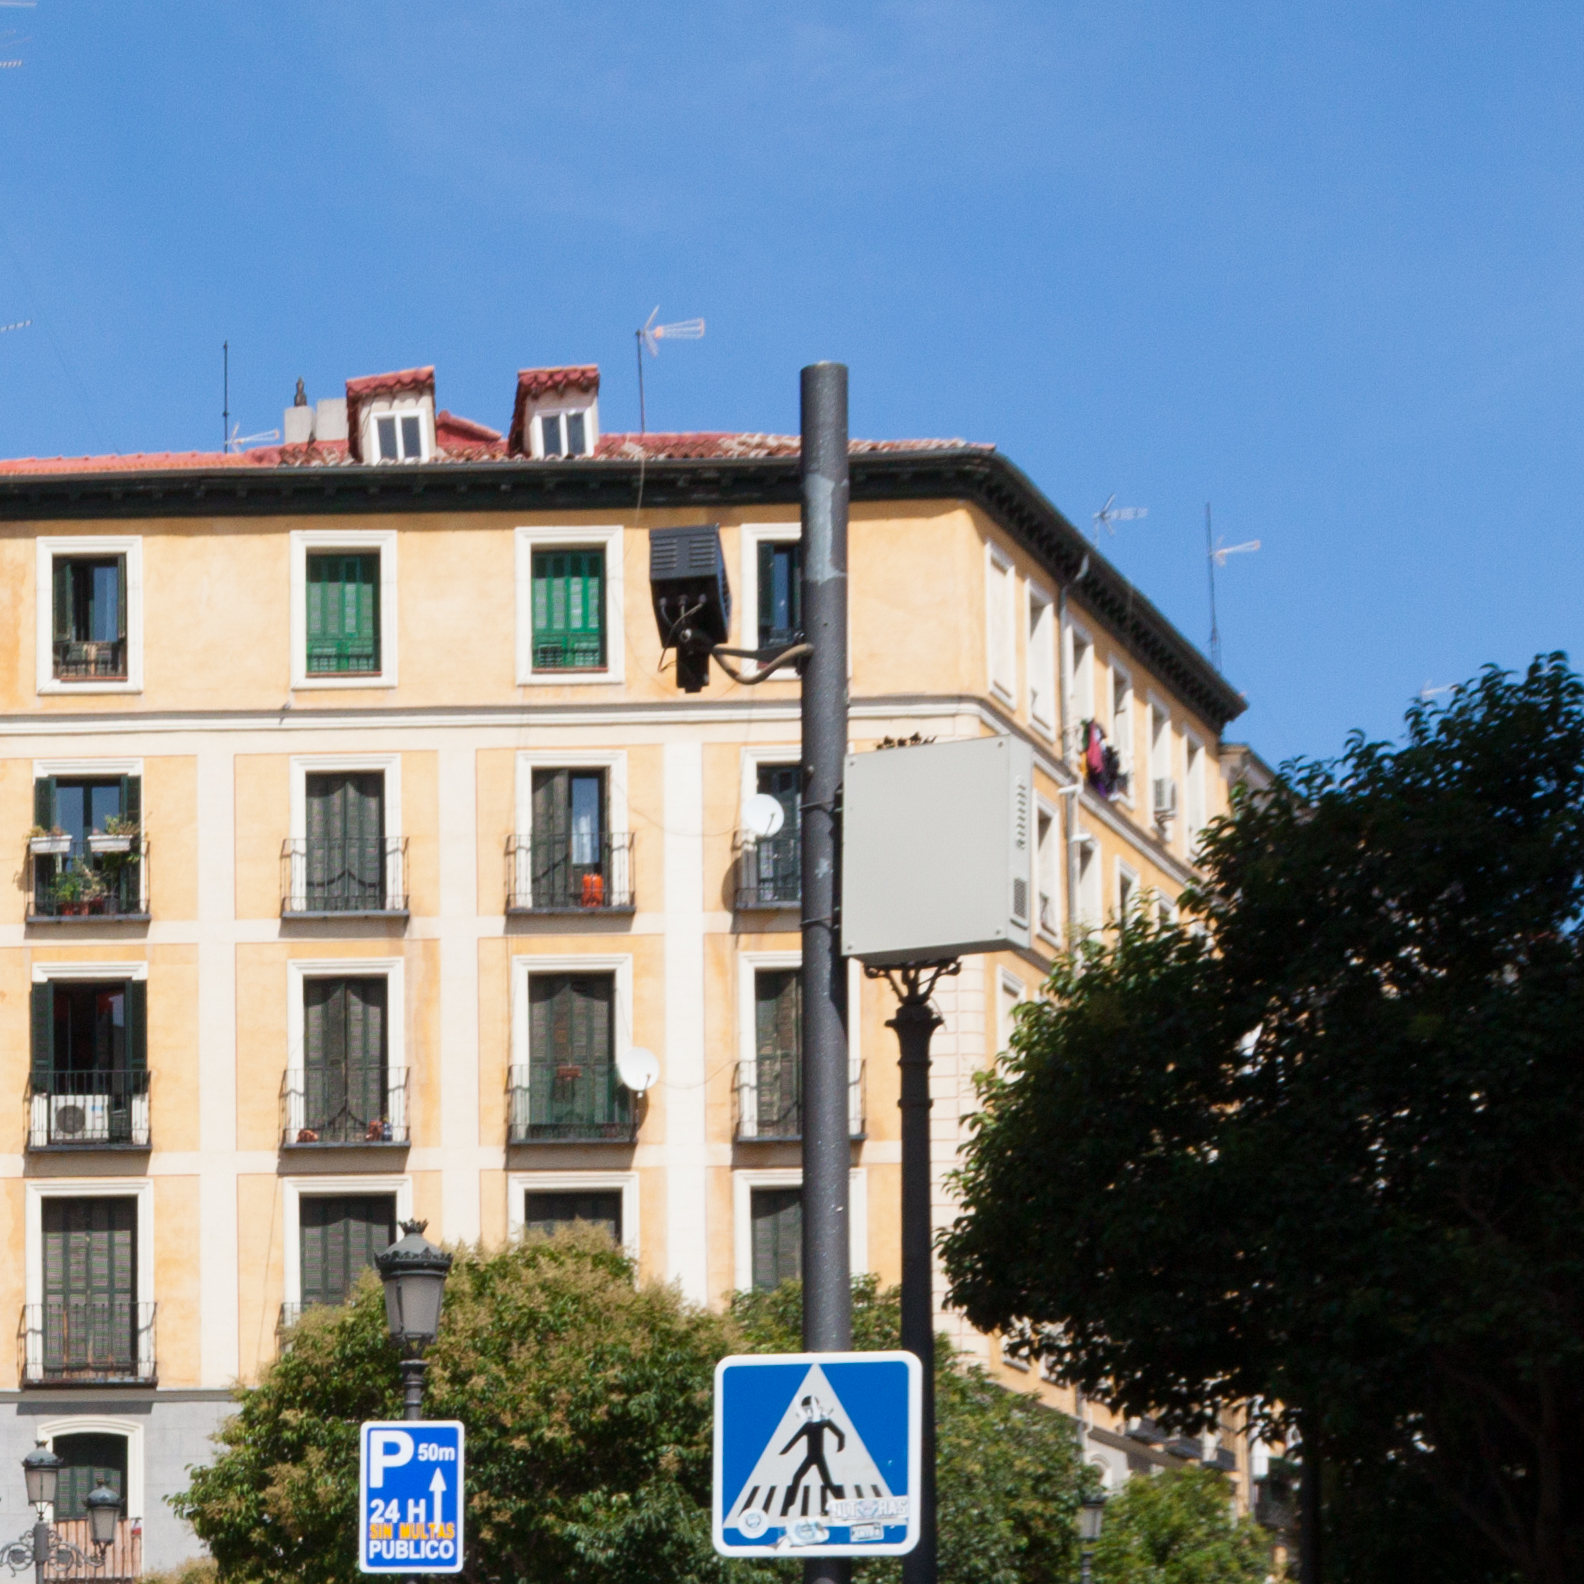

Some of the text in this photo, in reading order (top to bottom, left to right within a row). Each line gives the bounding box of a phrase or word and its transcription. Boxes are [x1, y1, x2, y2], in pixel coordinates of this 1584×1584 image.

[369, 1430, 455, 1488] P 50m
[370, 1498, 426, 1523] 24 H
[369, 1522, 455, 1540] SIN MULTAS
[369, 1540, 454, 1559] PUBLICO
